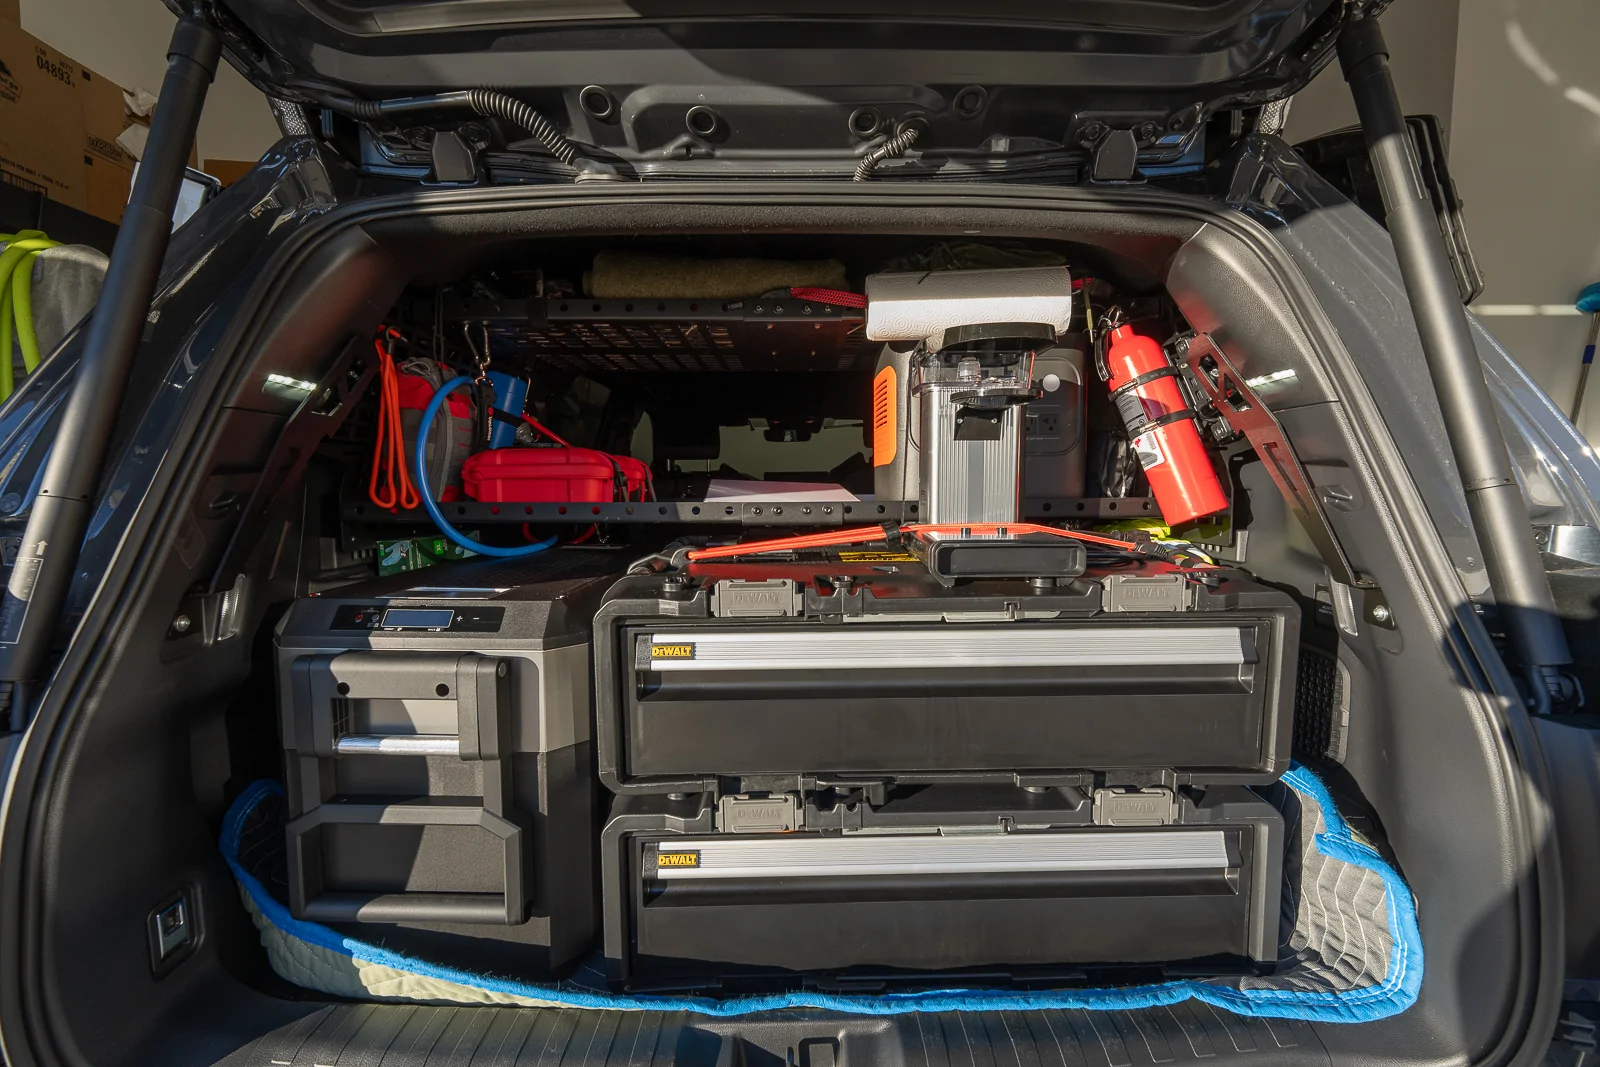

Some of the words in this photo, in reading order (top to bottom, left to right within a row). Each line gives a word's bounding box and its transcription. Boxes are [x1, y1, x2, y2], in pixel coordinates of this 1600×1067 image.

[36, 55, 71, 85] 04893
[734, 592, 780, 603] DEWALT
[652, 646, 691, 657] DEWALT
[658, 853, 697, 866] DEWALT
